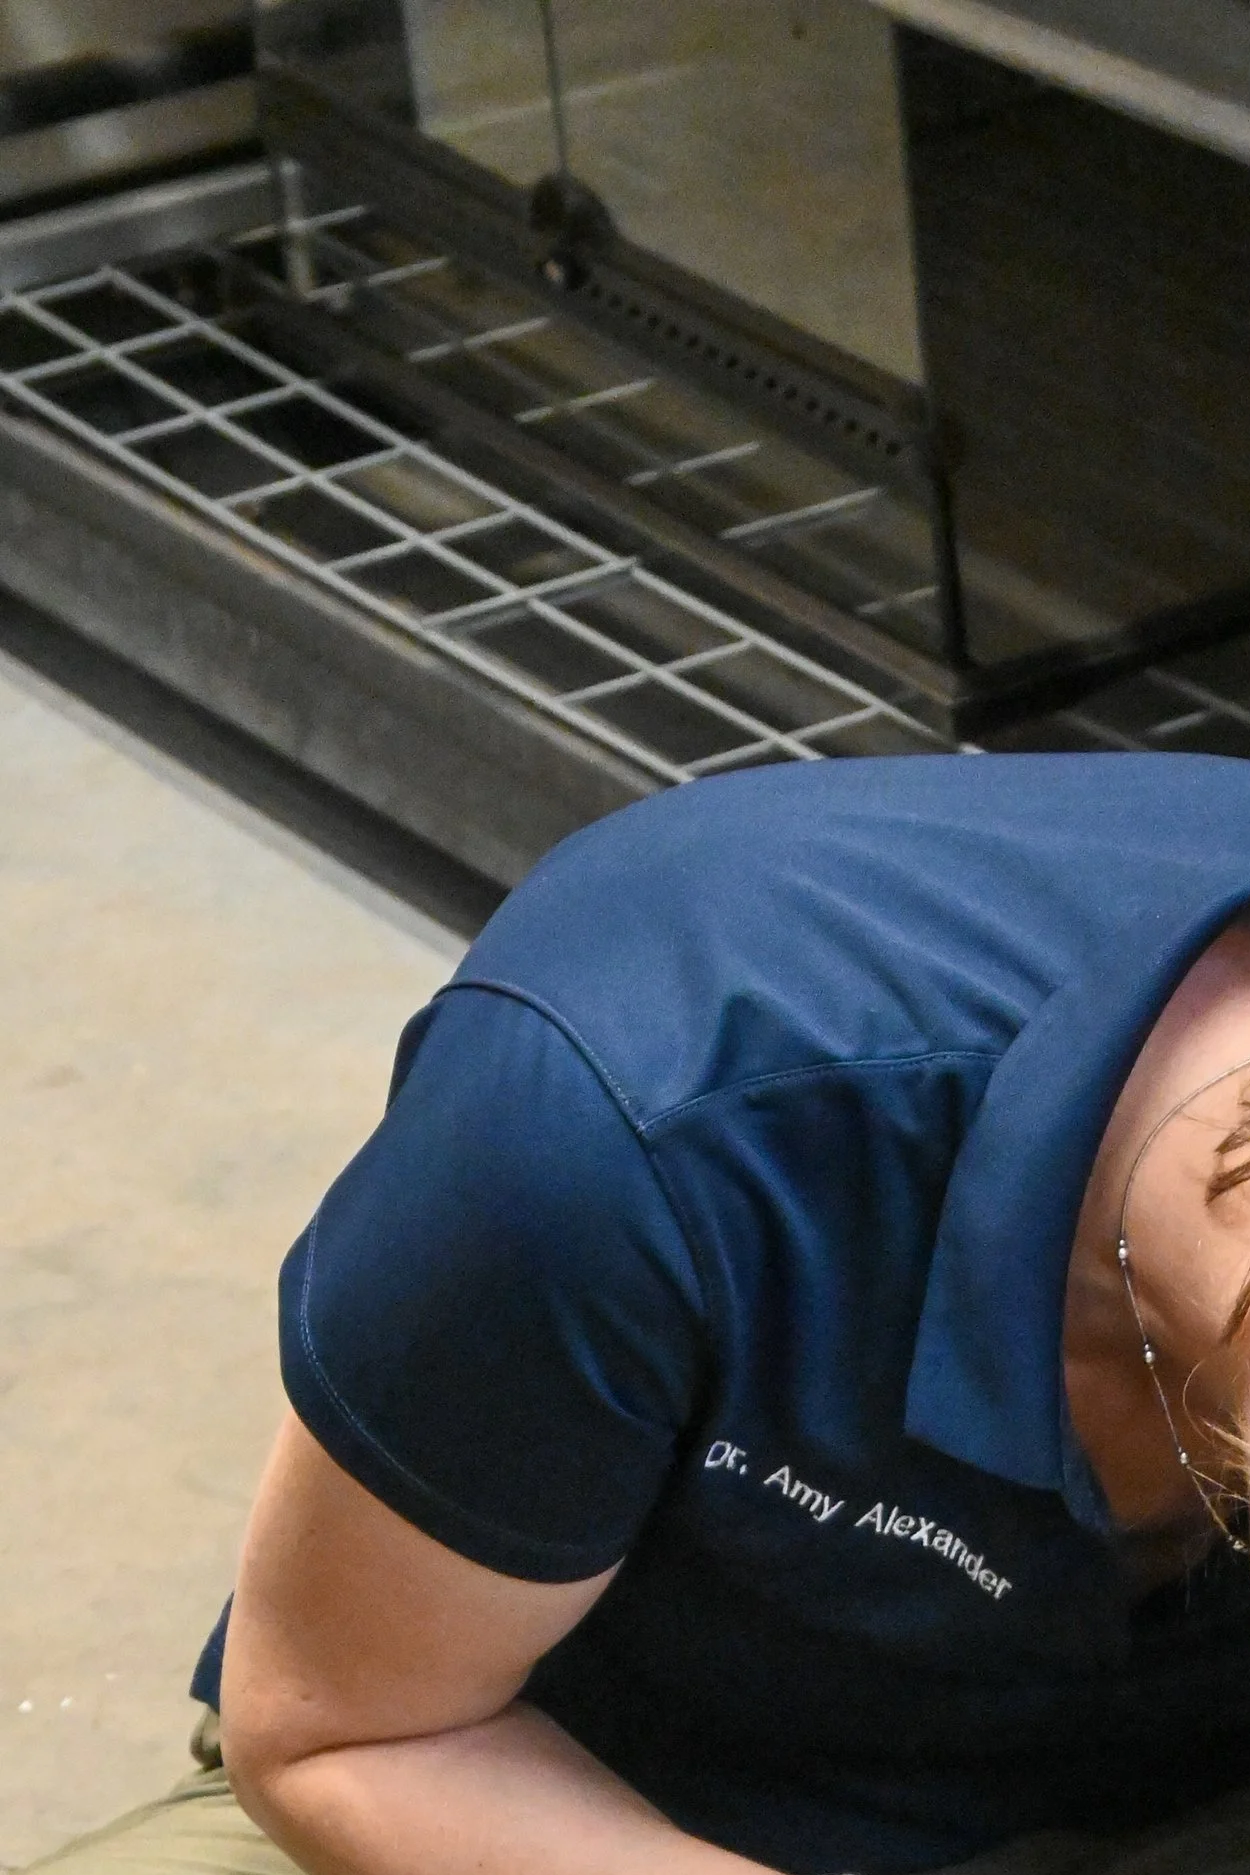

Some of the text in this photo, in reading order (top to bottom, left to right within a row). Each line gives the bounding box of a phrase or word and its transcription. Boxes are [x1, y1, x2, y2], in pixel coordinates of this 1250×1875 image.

[704, 1440, 1012, 1600] Dr. Amy Alexander
